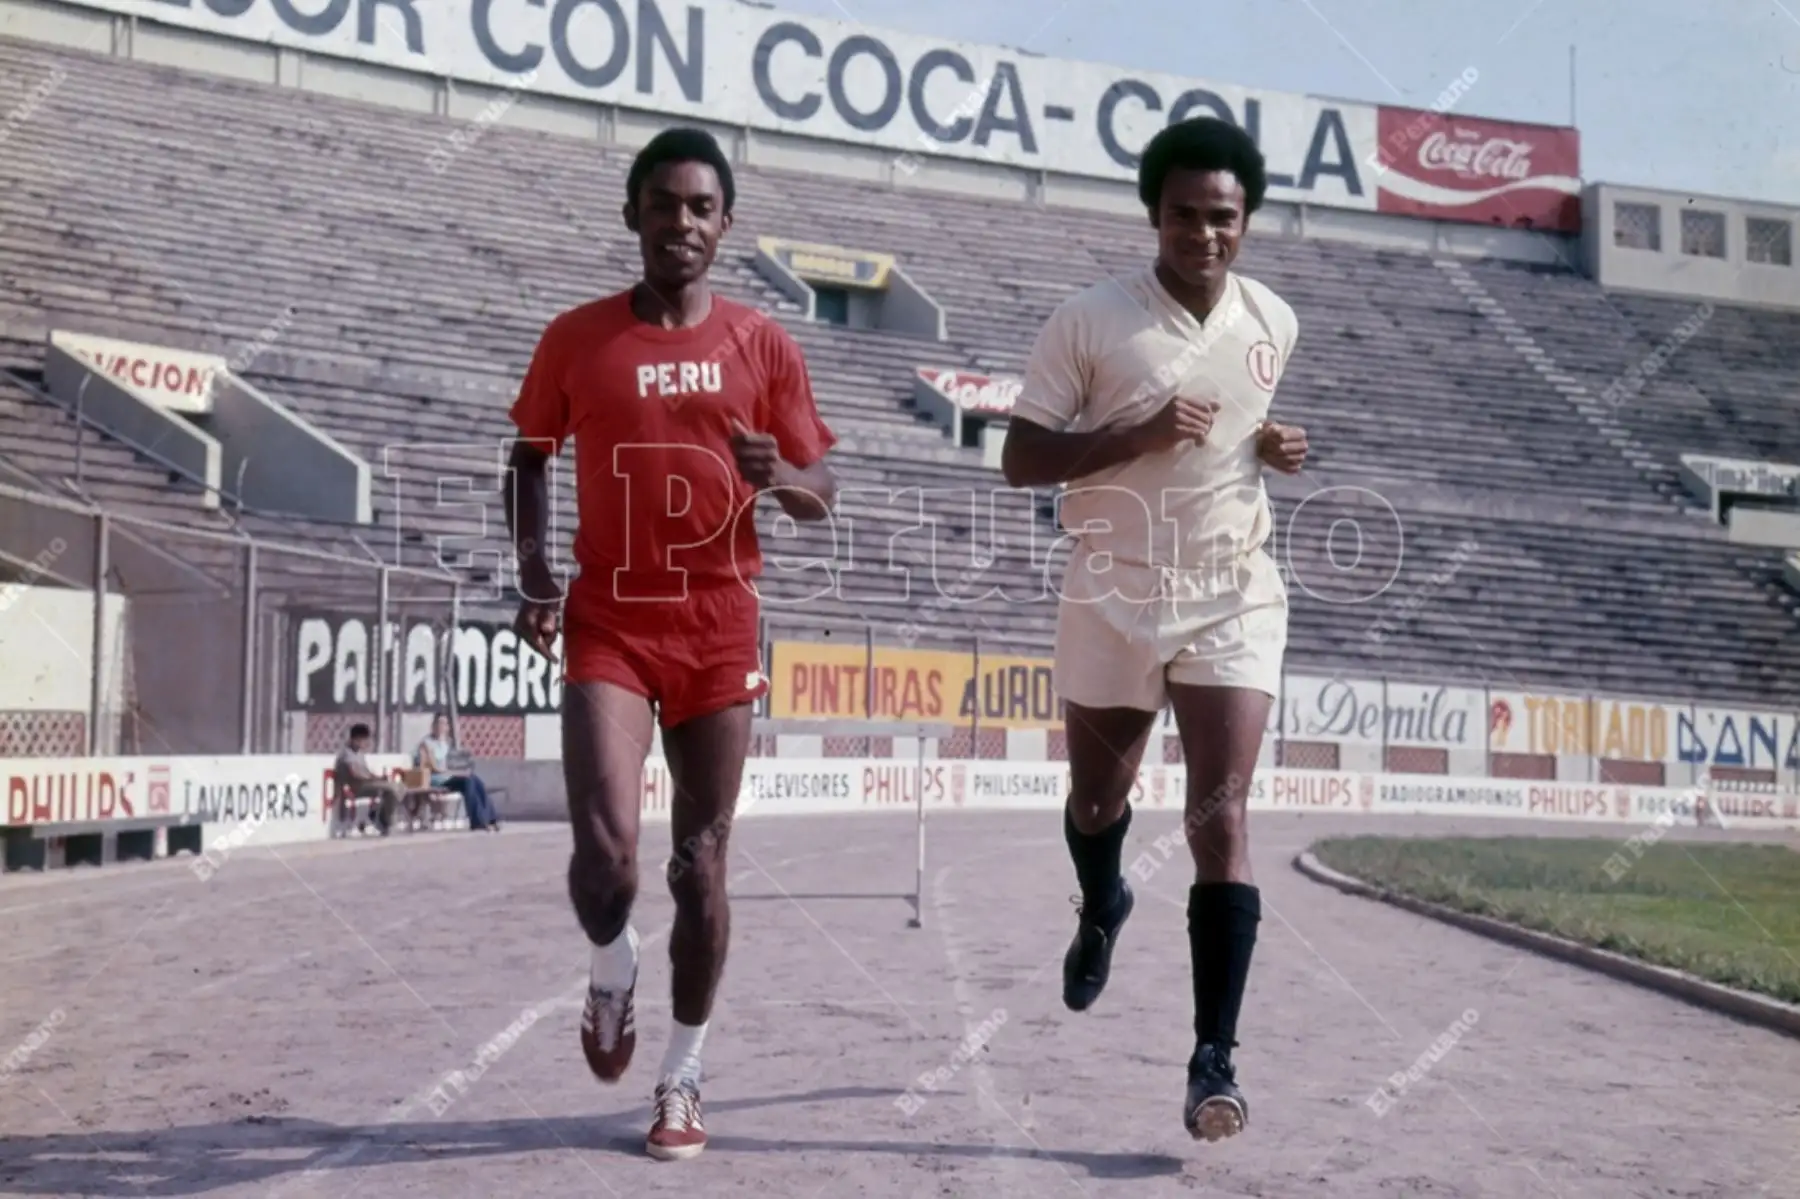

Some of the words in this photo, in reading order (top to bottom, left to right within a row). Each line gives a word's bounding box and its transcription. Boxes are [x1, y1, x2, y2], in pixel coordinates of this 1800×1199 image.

[471, 0, 704, 102] CON
[79, 349, 206, 396] VACION
[637, 360, 722, 398] PERU
[1255, 350, 1275, 386] U
[790, 662, 943, 718] PINTURAS
[959, 665, 1067, 720] AURO
[1307, 678, 1469, 744] Demila
[1524, 694, 1668, 760] TORNADO
[749, 772, 850, 800] TELEVISORES
[862, 766, 945, 805] PHILIPS
[1273, 776, 1351, 806] PHILIPS
[1528, 786, 1608, 817] PHILIPS
